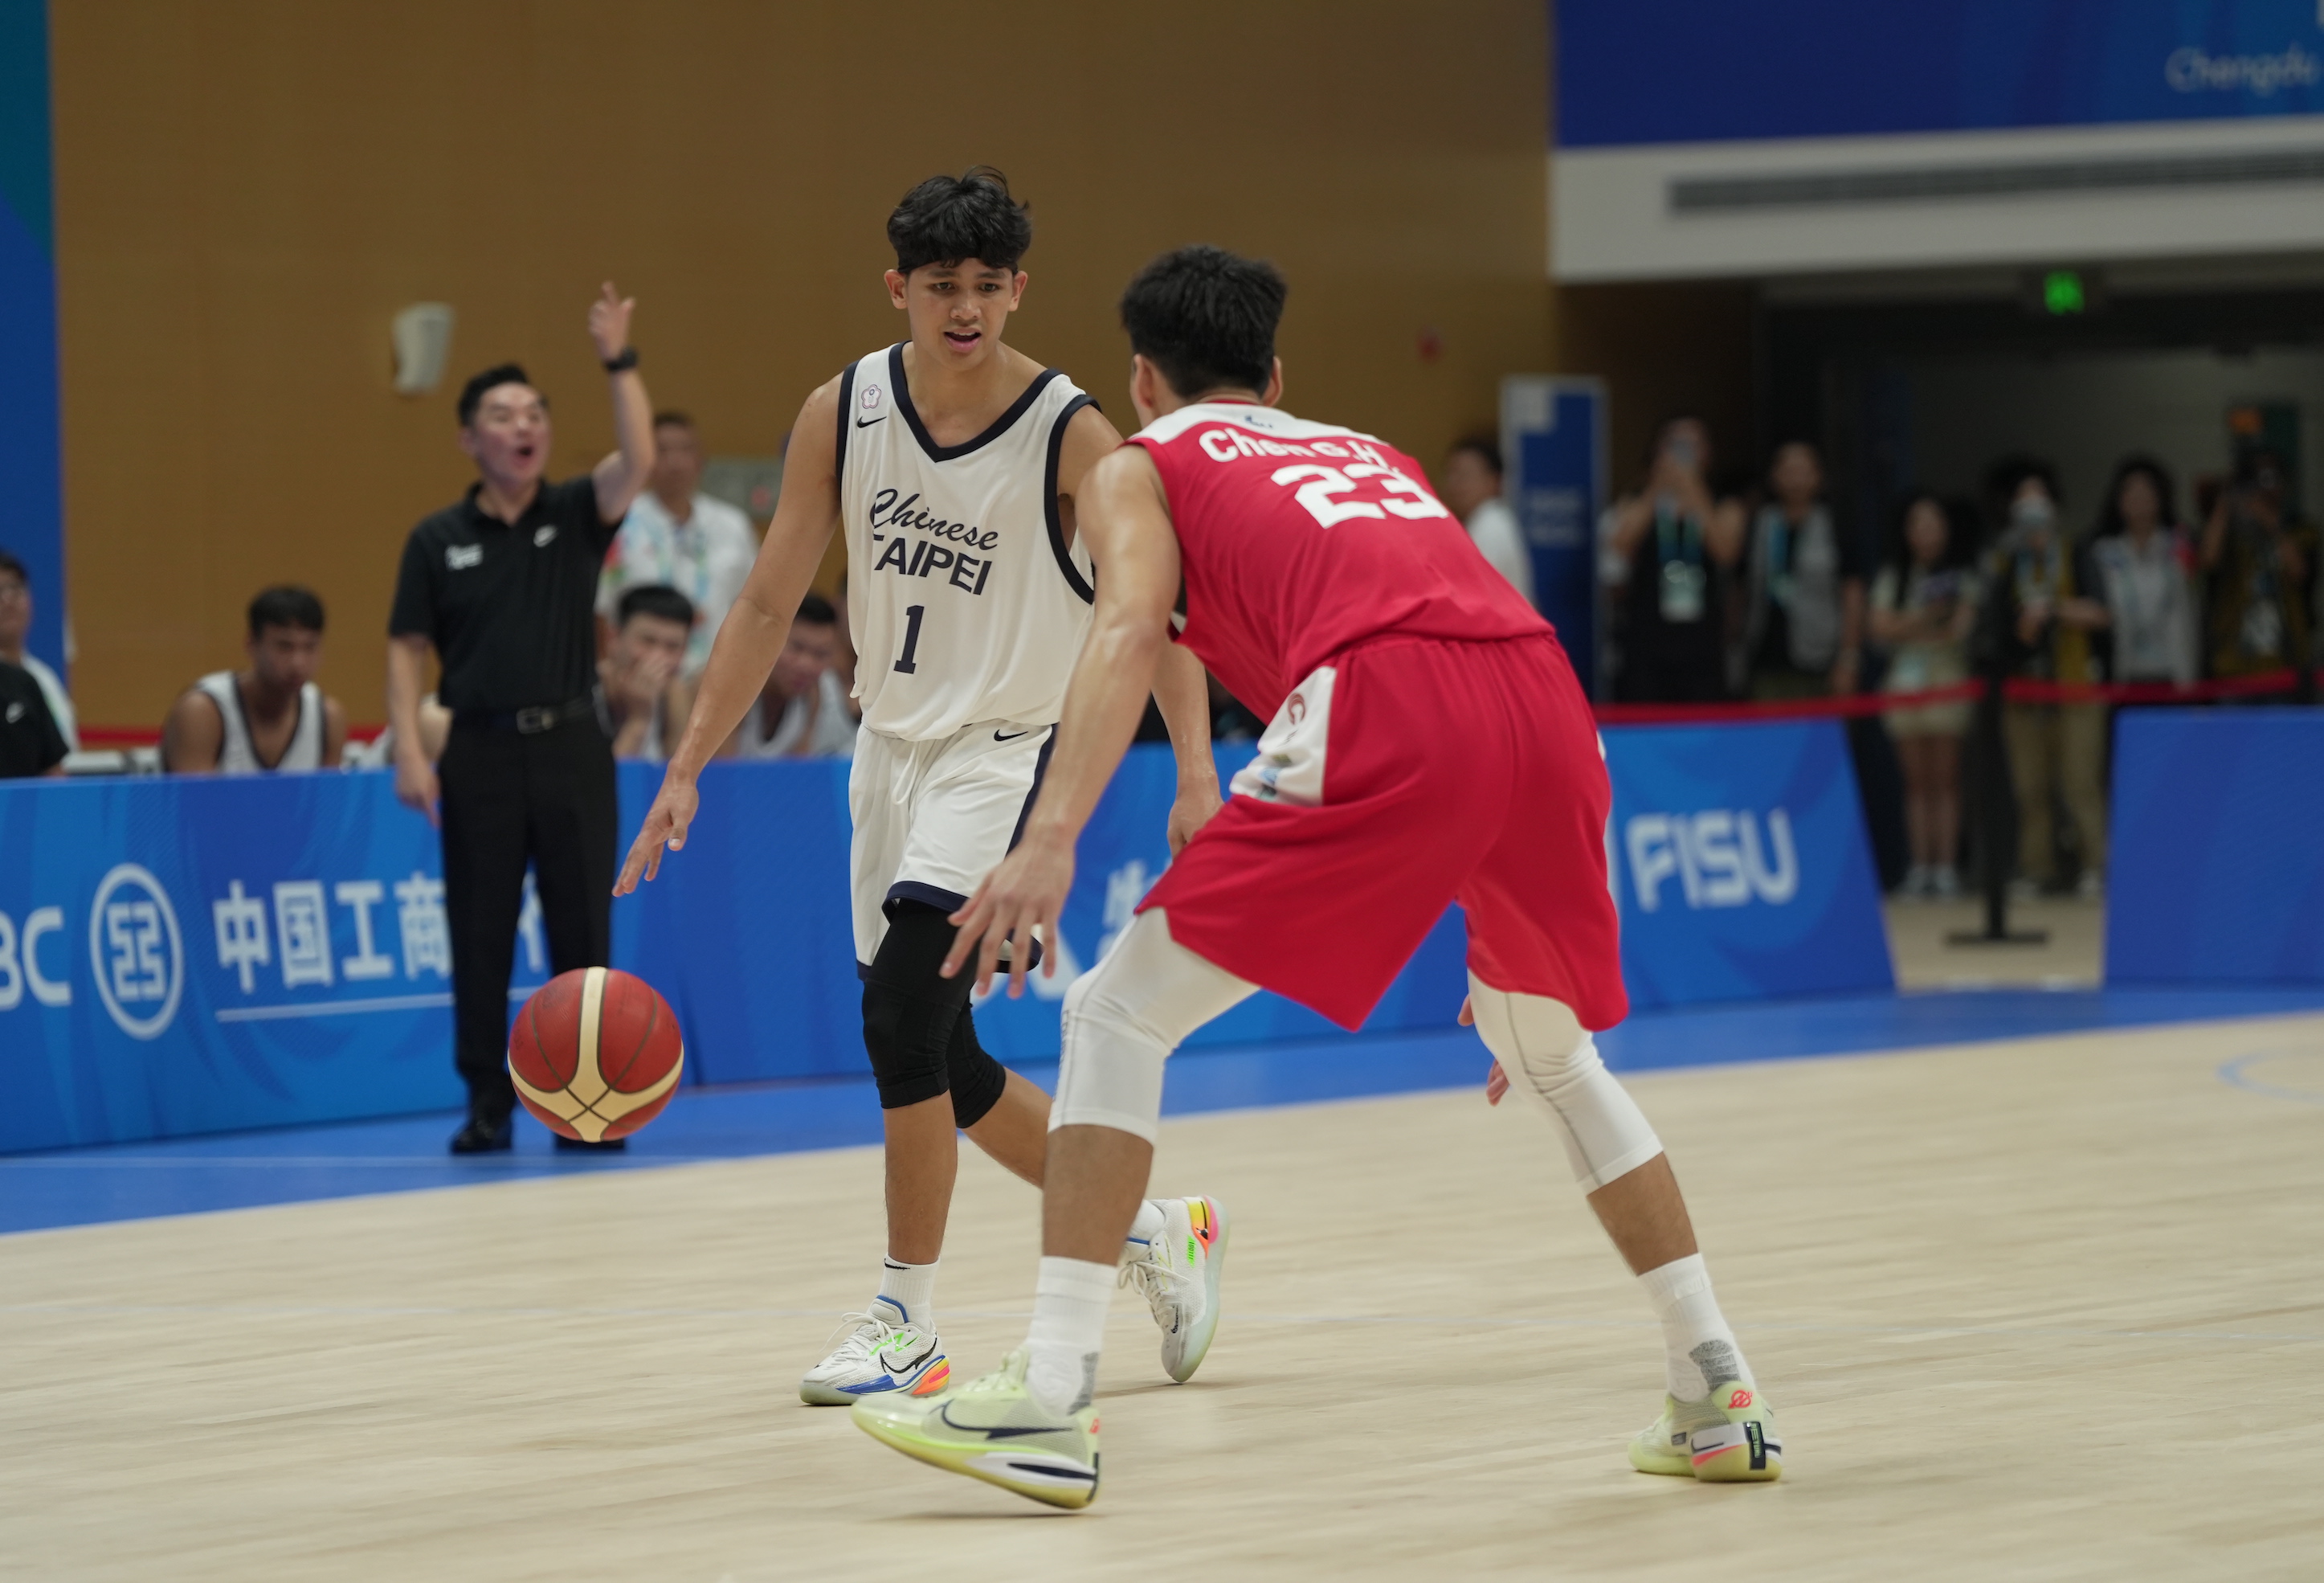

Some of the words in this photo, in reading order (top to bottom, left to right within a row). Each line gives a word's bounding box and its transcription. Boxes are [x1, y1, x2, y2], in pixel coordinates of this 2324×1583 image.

[1199, 427, 1317, 463] Chen
[869, 488, 999, 551] Chinese
[1271, 463, 1449, 530] 23
[893, 604, 925, 675] 1
[1624, 806, 1799, 913] FISU
[212, 870, 544, 995] 中国工商
